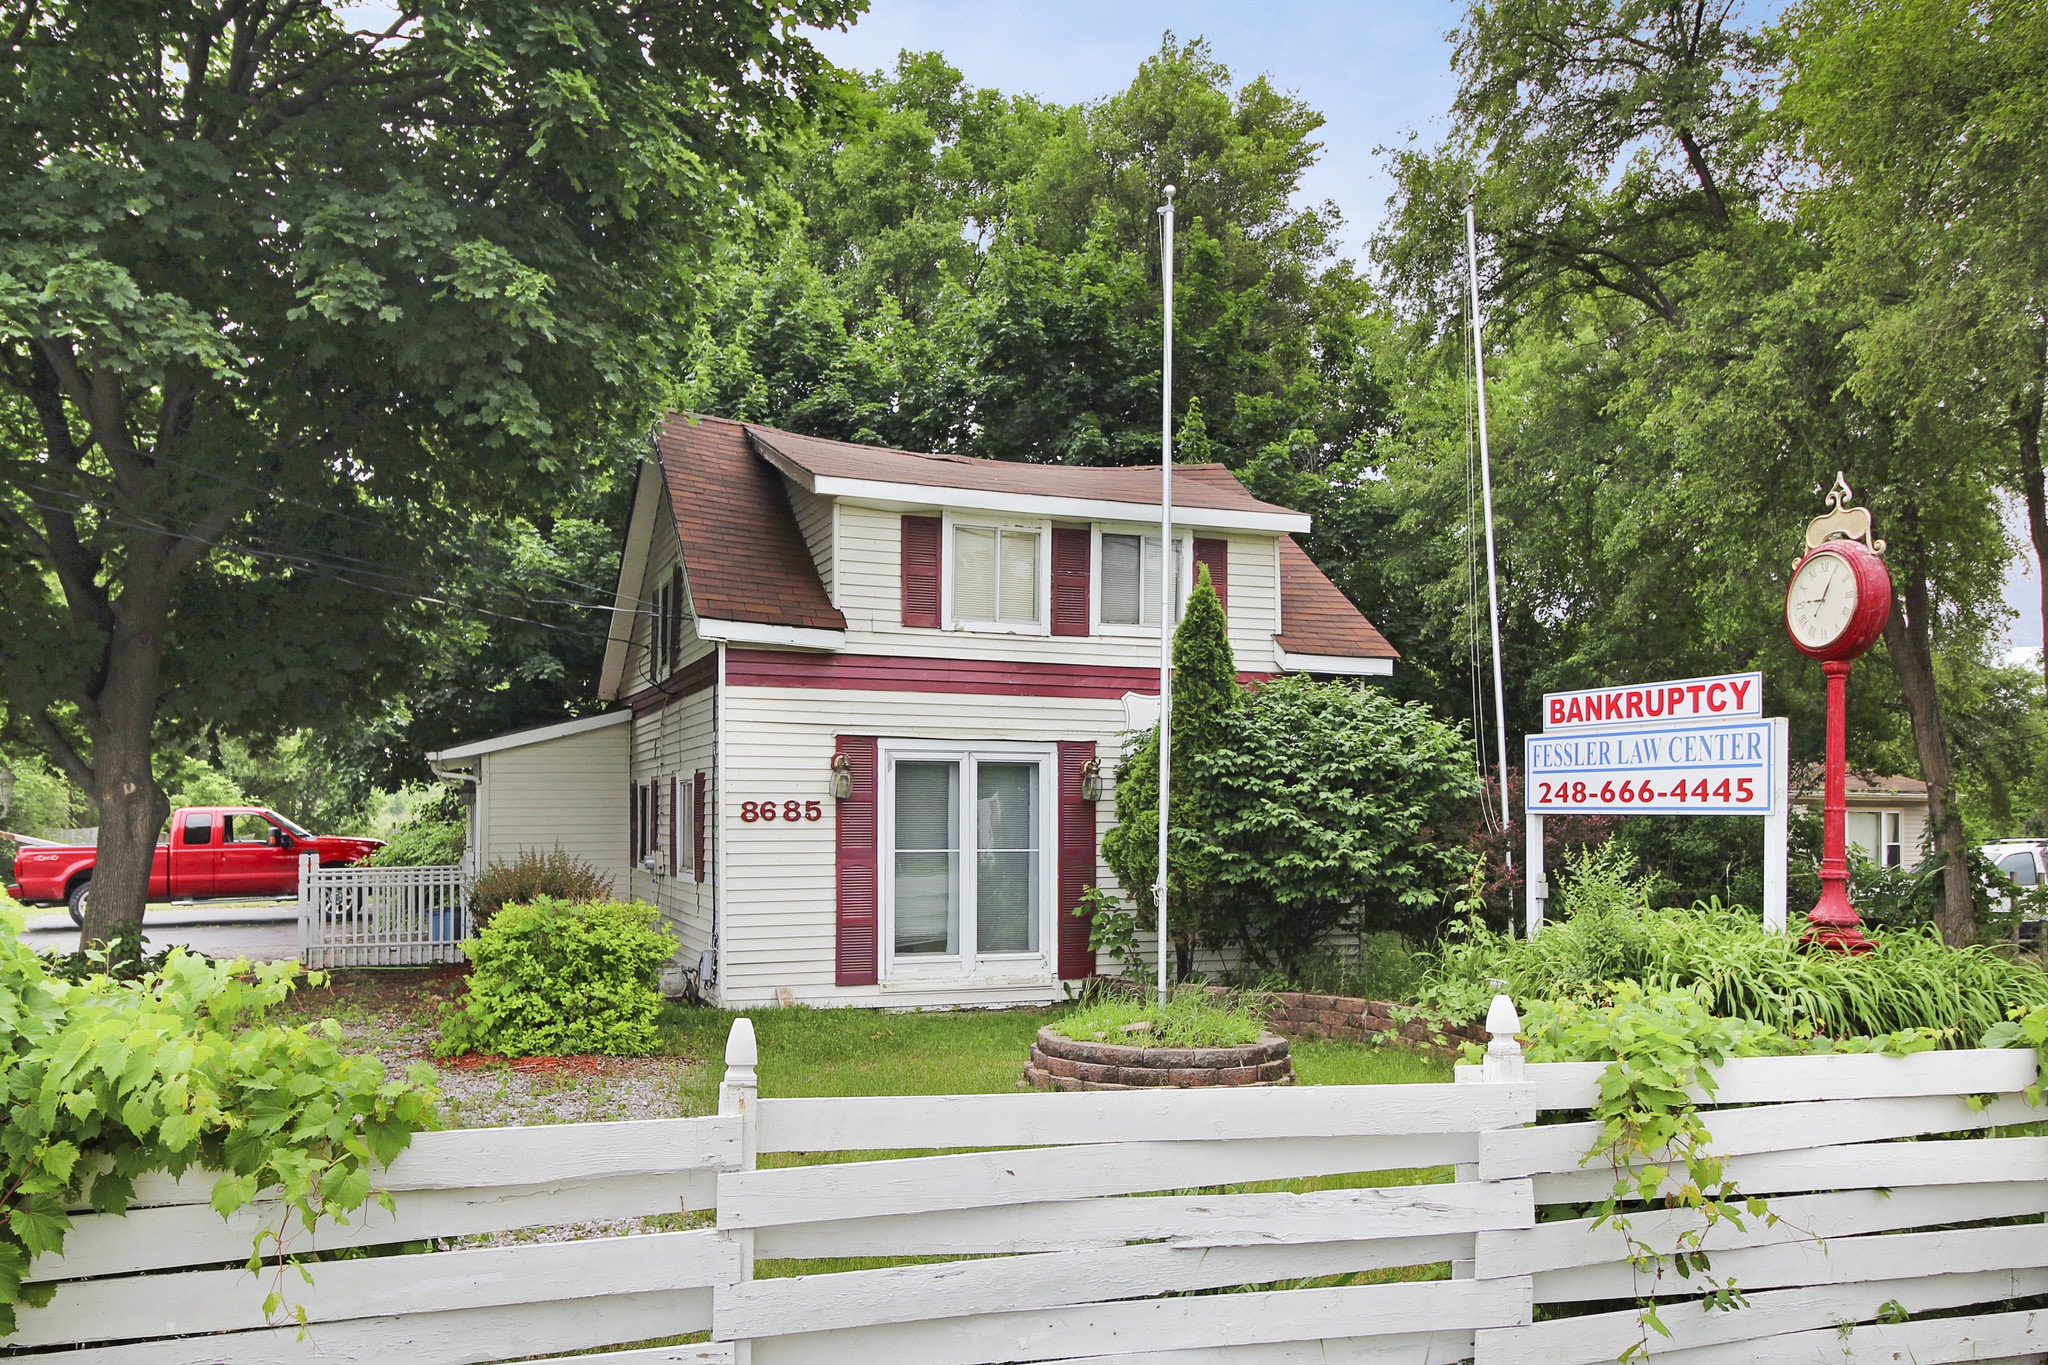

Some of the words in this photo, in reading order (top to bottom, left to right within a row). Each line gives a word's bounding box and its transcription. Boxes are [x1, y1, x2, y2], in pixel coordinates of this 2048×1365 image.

[1550, 680, 1752, 724] BANKRUPTCY
[1533, 740, 1610, 768] FESSLER
[1617, 737, 1662, 765] LAW
[1668, 732, 1762, 763] CENTER
[1538, 777, 1754, 804] 248-666-4445
[740, 800, 822, 823] 8685
